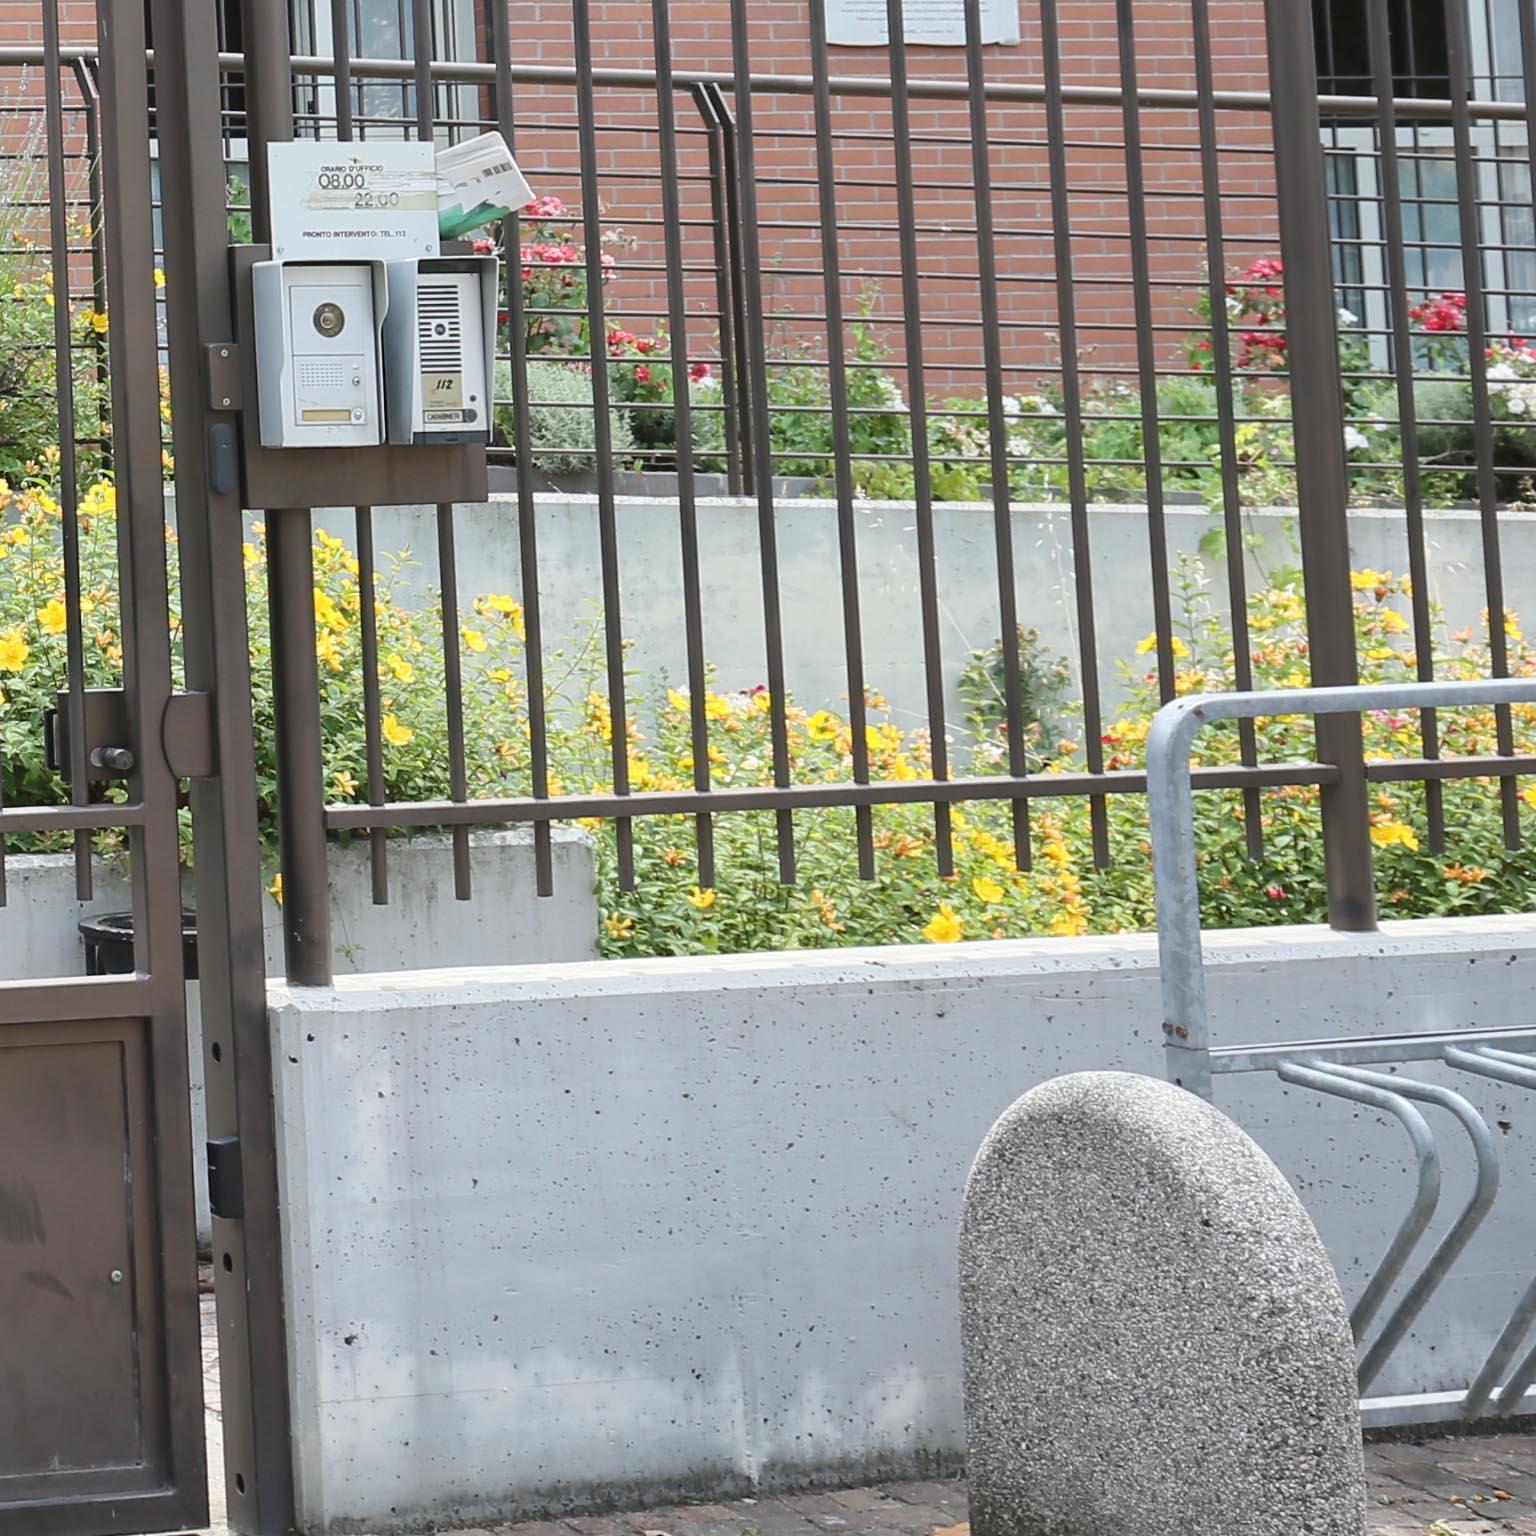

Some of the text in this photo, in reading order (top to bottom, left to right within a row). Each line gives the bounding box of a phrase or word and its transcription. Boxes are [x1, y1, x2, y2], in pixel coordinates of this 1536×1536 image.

[318, 172, 365, 190] 08.00
[302, 230, 332, 238] PRONTO
[436, 378, 454, 391] 112
